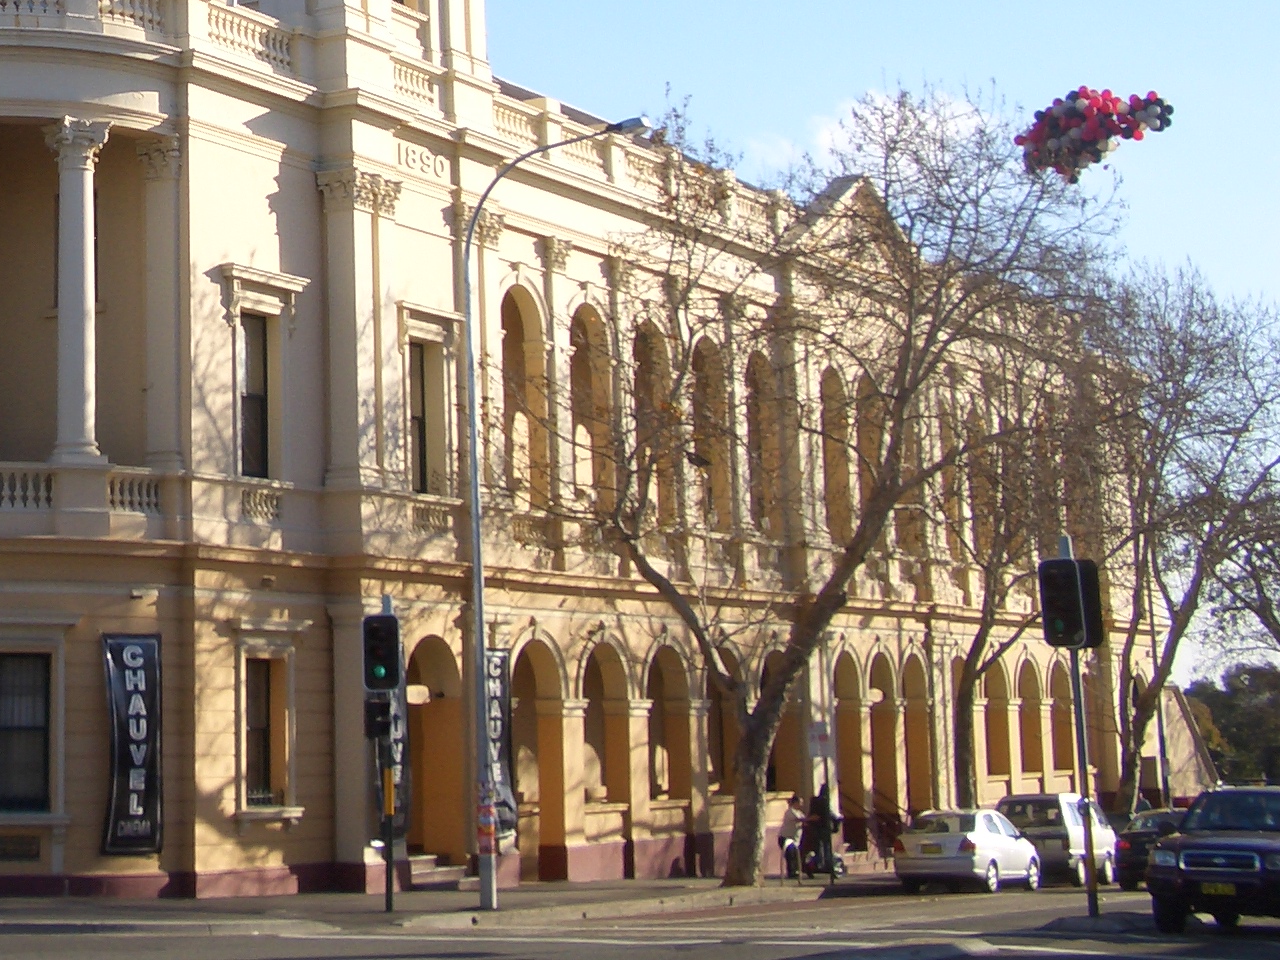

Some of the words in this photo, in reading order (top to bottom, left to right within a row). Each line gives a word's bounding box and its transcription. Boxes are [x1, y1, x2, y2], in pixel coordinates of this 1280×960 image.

[397, 142, 445, 179] 1890
[122, 645, 148, 816] CHAUVEL
[489, 656, 503, 782] CHAUVE
